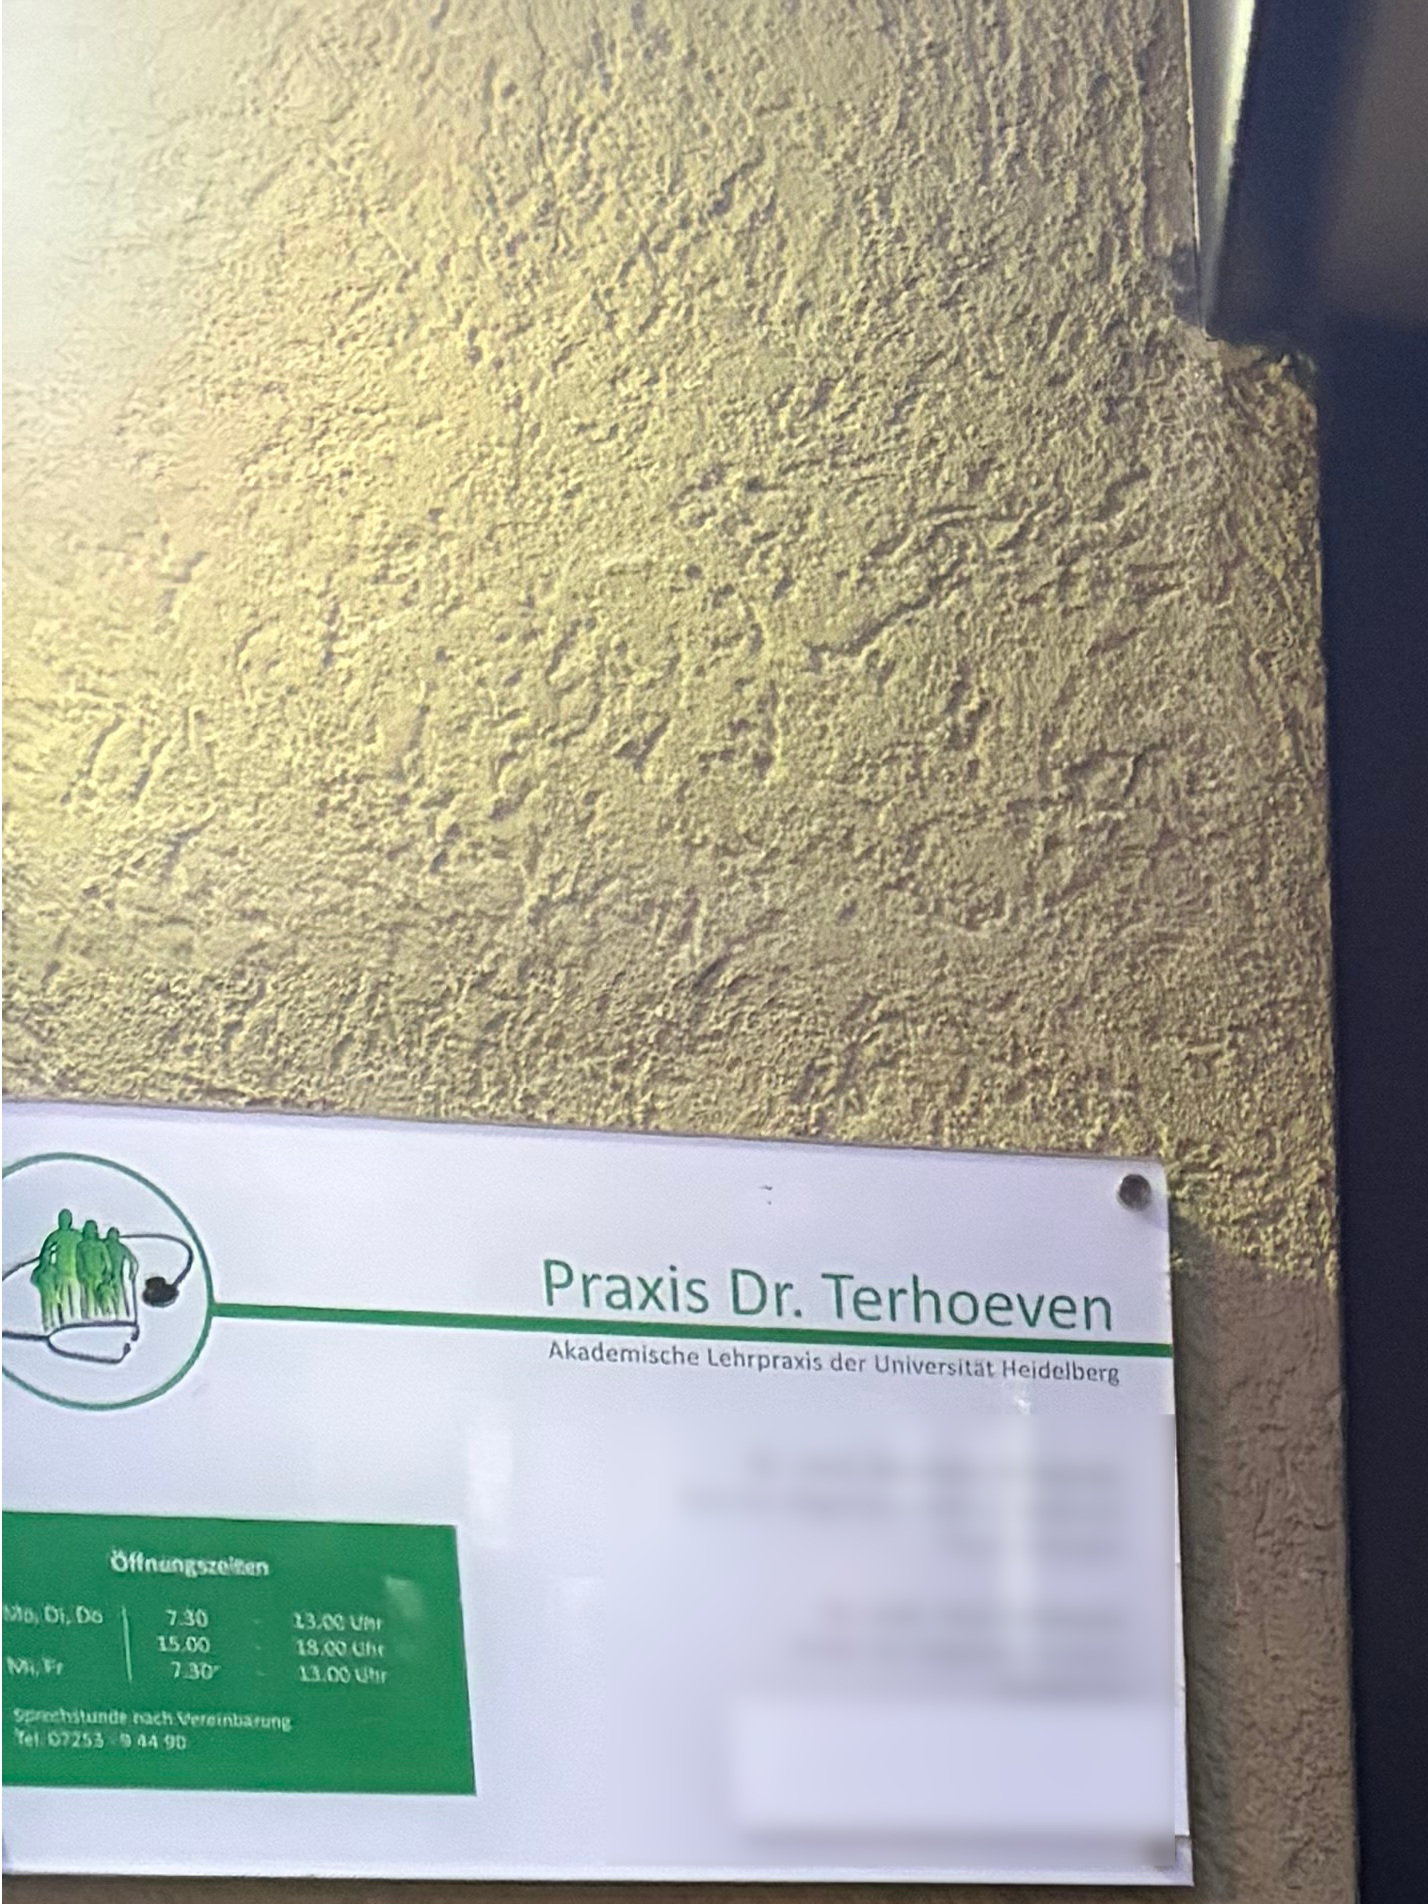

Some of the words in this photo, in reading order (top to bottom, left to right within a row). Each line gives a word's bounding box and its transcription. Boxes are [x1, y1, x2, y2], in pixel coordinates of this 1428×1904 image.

[543, 1258, 709, 1314] Praxis
[731, 1268, 802, 1317] Dr.
[821, 1273, 1112, 1331] Terhoeven
[548, 1339, 699, 1366] Akademische
[707, 1346, 823, 1372] Lehrpraxis
[830, 1353, 866, 1373] der
[875, 1354, 994, 1378] Universität
[1002, 1359, 1120, 1386] Heidelberg
[109, 1547, 270, 1578] Öffnungszeiten
[75, 1605, 104, 1624] Do
[349, 1613, 384, 1632] Uhr
[156, 1636, 211, 1654] 15.00
[351, 1641, 386, 1658] Uhr
[354, 1666, 388, 1684] Uhr
[12, 1707, 128, 1727] Sprechstunde
[132, 1711, 172, 1727] nach
[176, 1711, 294, 1734] Vereinbarung
